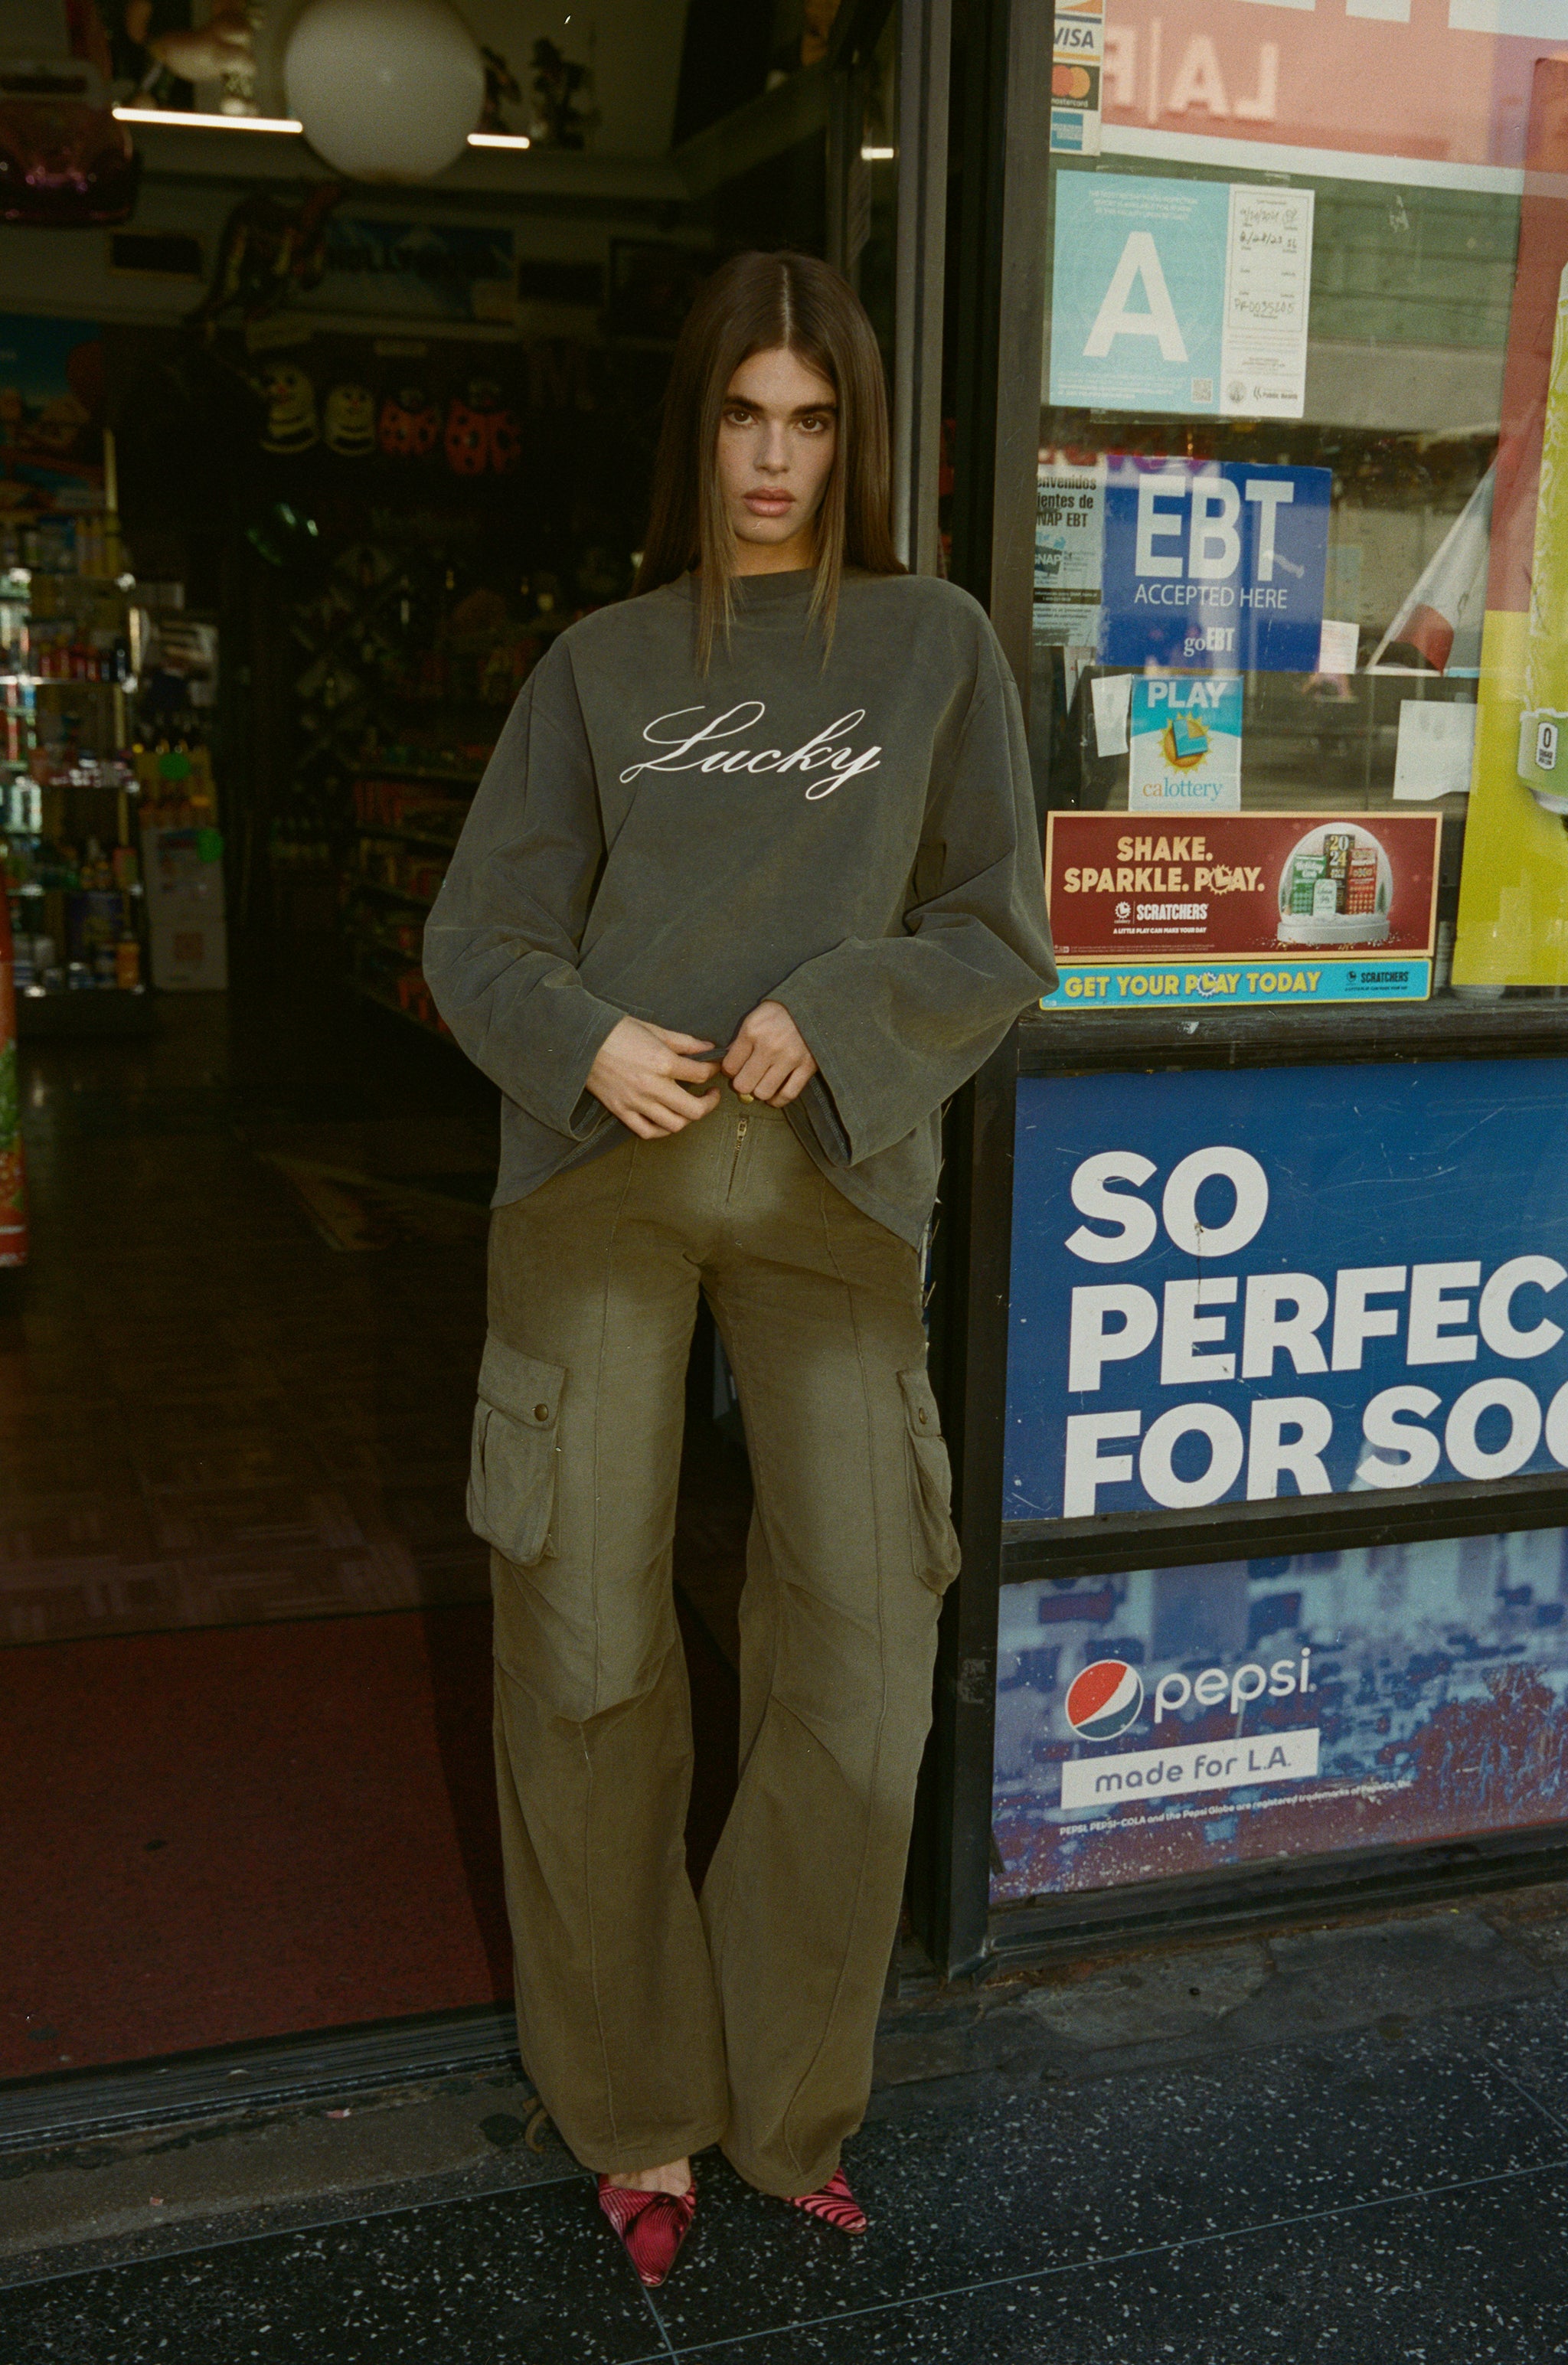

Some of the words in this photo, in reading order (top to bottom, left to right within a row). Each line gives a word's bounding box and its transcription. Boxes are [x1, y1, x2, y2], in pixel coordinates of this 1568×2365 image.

[1083, 231, 1189, 362] A
[1079, 494, 1093, 509] de
[1067, 512, 1088, 528] EBT
[1135, 474, 1295, 581] EBT
[1134, 583, 1235, 607] ACCEPTED
[1240, 587, 1288, 609] HERE
[1148, 681, 1228, 709] PLAY
[619, 701, 882, 800] Lucky
[1142, 776, 1224, 802] calottery
[1116, 836, 1214, 862] SHAKE.
[1063, 867, 1190, 893] SPARKLE.
[1194, 865, 1266, 894] PLAY.
[1136, 903, 1209, 921] SCRATCHERS
[1064, 975, 1110, 998] GET
[1116, 974, 1180, 997] YOUR
[1185, 972, 1242, 998] PLAY
[1246, 972, 1322, 994] TODAY
[1361, 971, 1410, 984] SCRATCHERS
[1064, 1146, 1269, 1263] SO
[1068, 1255, 1568, 1393] PERFEC
[1063, 1396, 1333, 1518] FOR
[1355, 1378, 1568, 1490] SO
[1154, 1647, 1312, 1723] pepsi
[1095, 1761, 1184, 1793] made
[1194, 1754, 1238, 1779] for
[1248, 1746, 1292, 1772] L.A.
[1089, 1815, 1146, 1831] PEPSI-COLA
[1148, 1815, 1165, 1824] and
[1166, 1812, 1181, 1821] the
[1183, 1806, 1207, 1818] Pepsi
[1208, 1804, 1234, 1815] Globe
[1236, 1802, 1252, 1811] are
